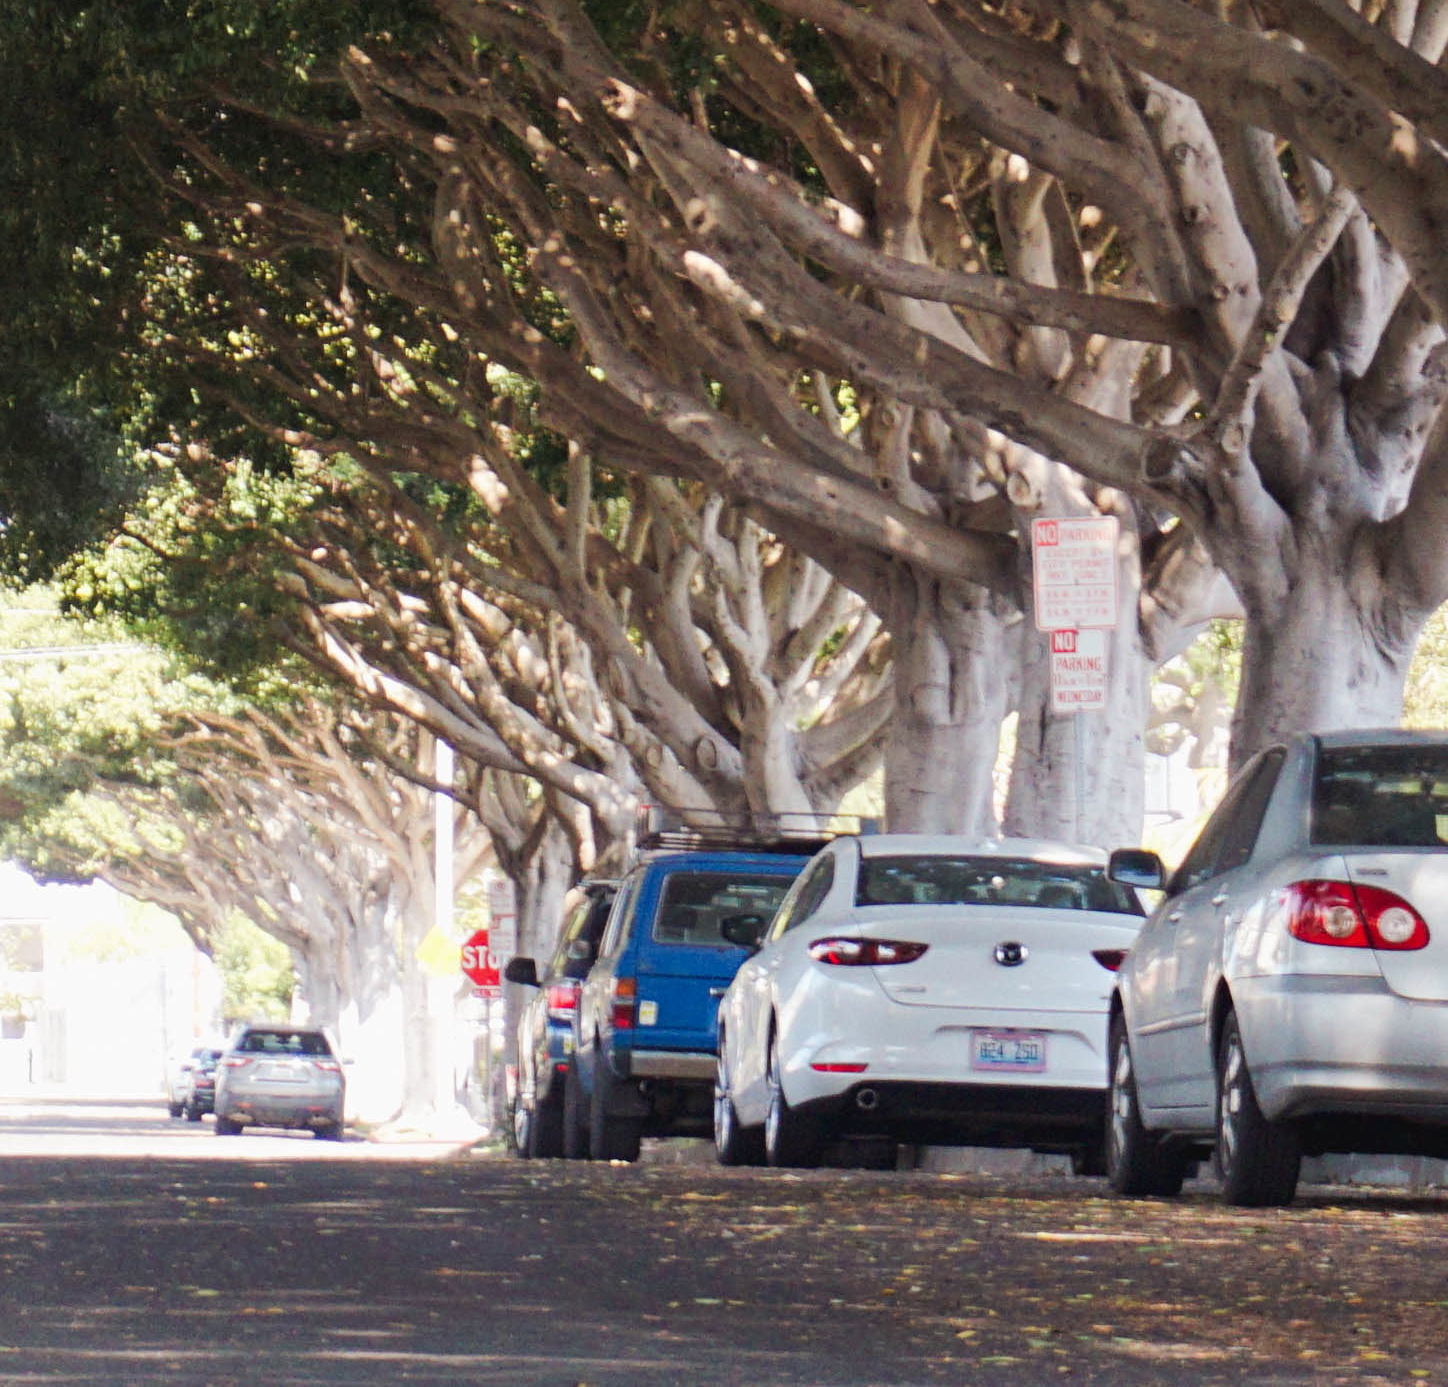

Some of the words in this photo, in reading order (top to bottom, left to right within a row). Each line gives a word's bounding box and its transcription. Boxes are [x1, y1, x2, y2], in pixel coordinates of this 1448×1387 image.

[1037, 524, 1056, 543] NO
[1054, 632, 1074, 650] NO
[1056, 657, 1101, 671] PARKING
[461, 945, 501, 969] STO
